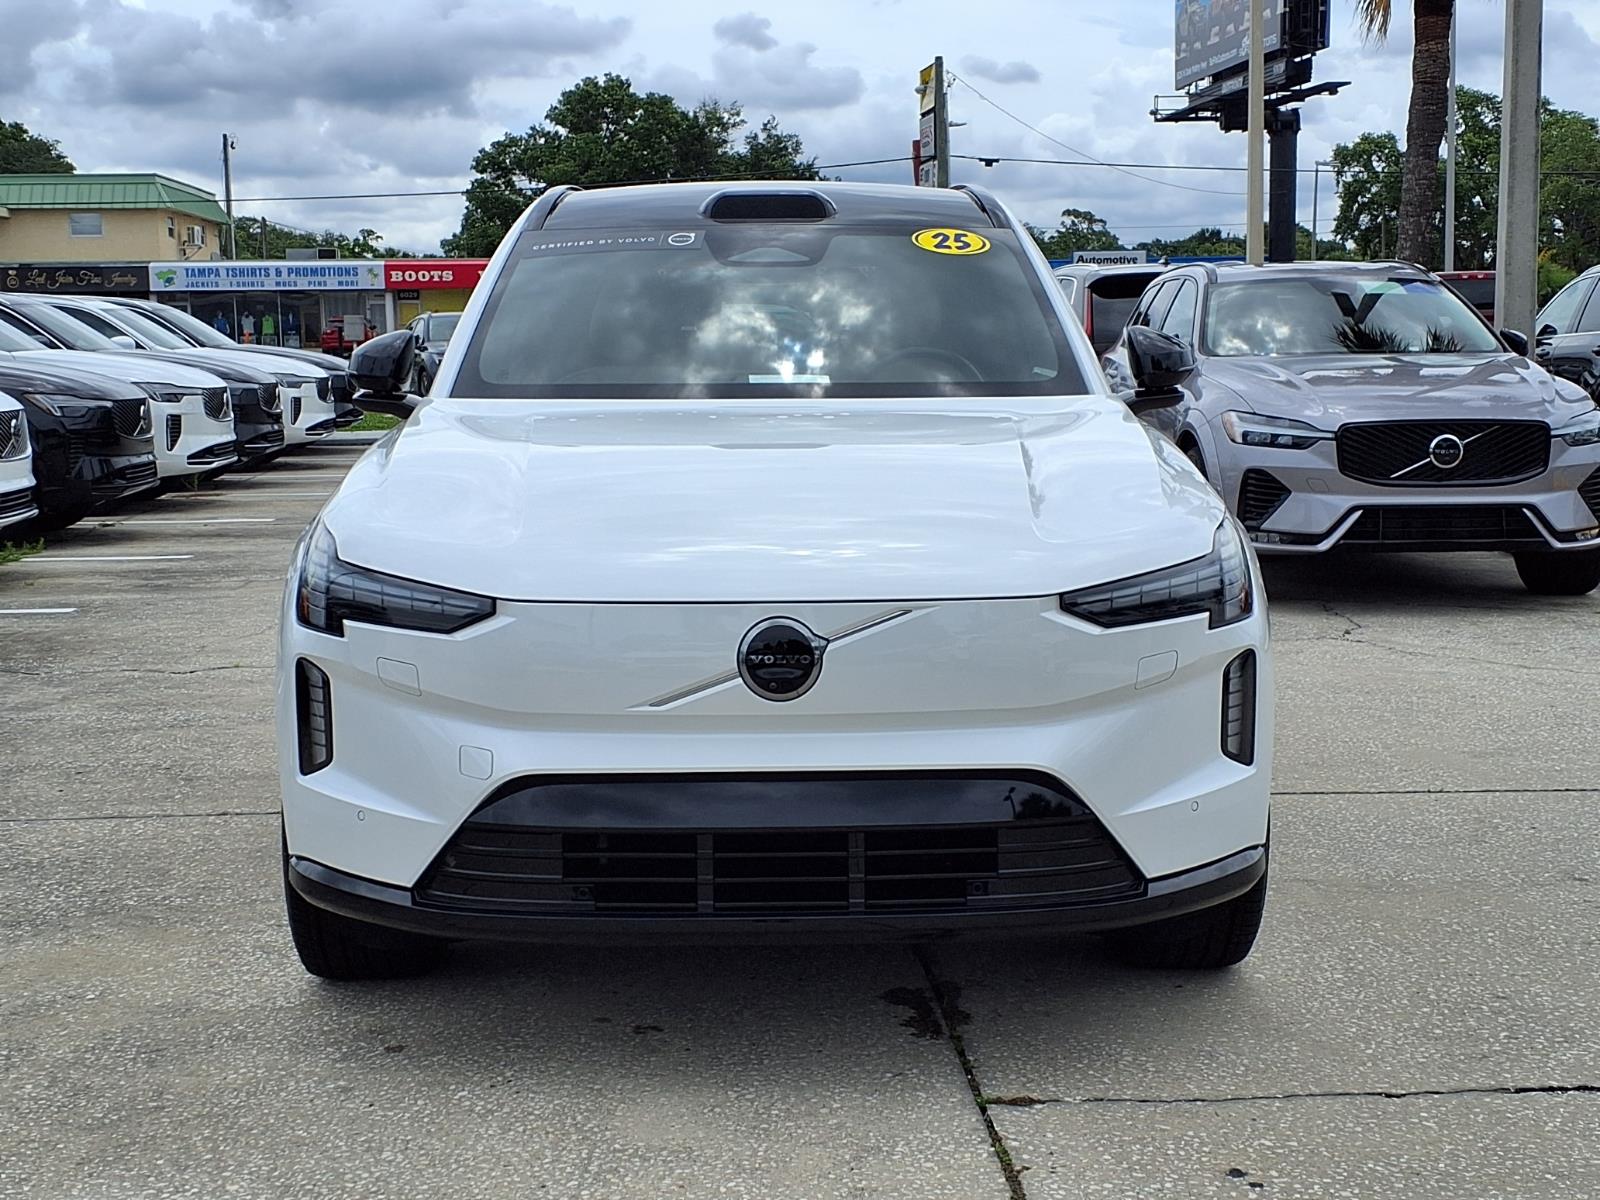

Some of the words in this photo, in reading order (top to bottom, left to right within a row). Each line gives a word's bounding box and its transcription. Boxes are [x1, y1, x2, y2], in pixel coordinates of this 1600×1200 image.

[532, 240, 594, 250] CERTIFIED
[930, 231, 972, 250] 25
[1075, 255, 1139, 264] Automotive
[184, 267, 221, 278] TAMPA
[225, 267, 270, 278] TSHIRTS
[275, 267, 282, 277] &
[287, 266, 359, 277] PROMOTIONS
[389, 270, 454, 282] BOOTS
[274, 280, 298, 288] MUGS
[399, 291, 418, 299] 6029
[750, 655, 812, 664] VOLVO
